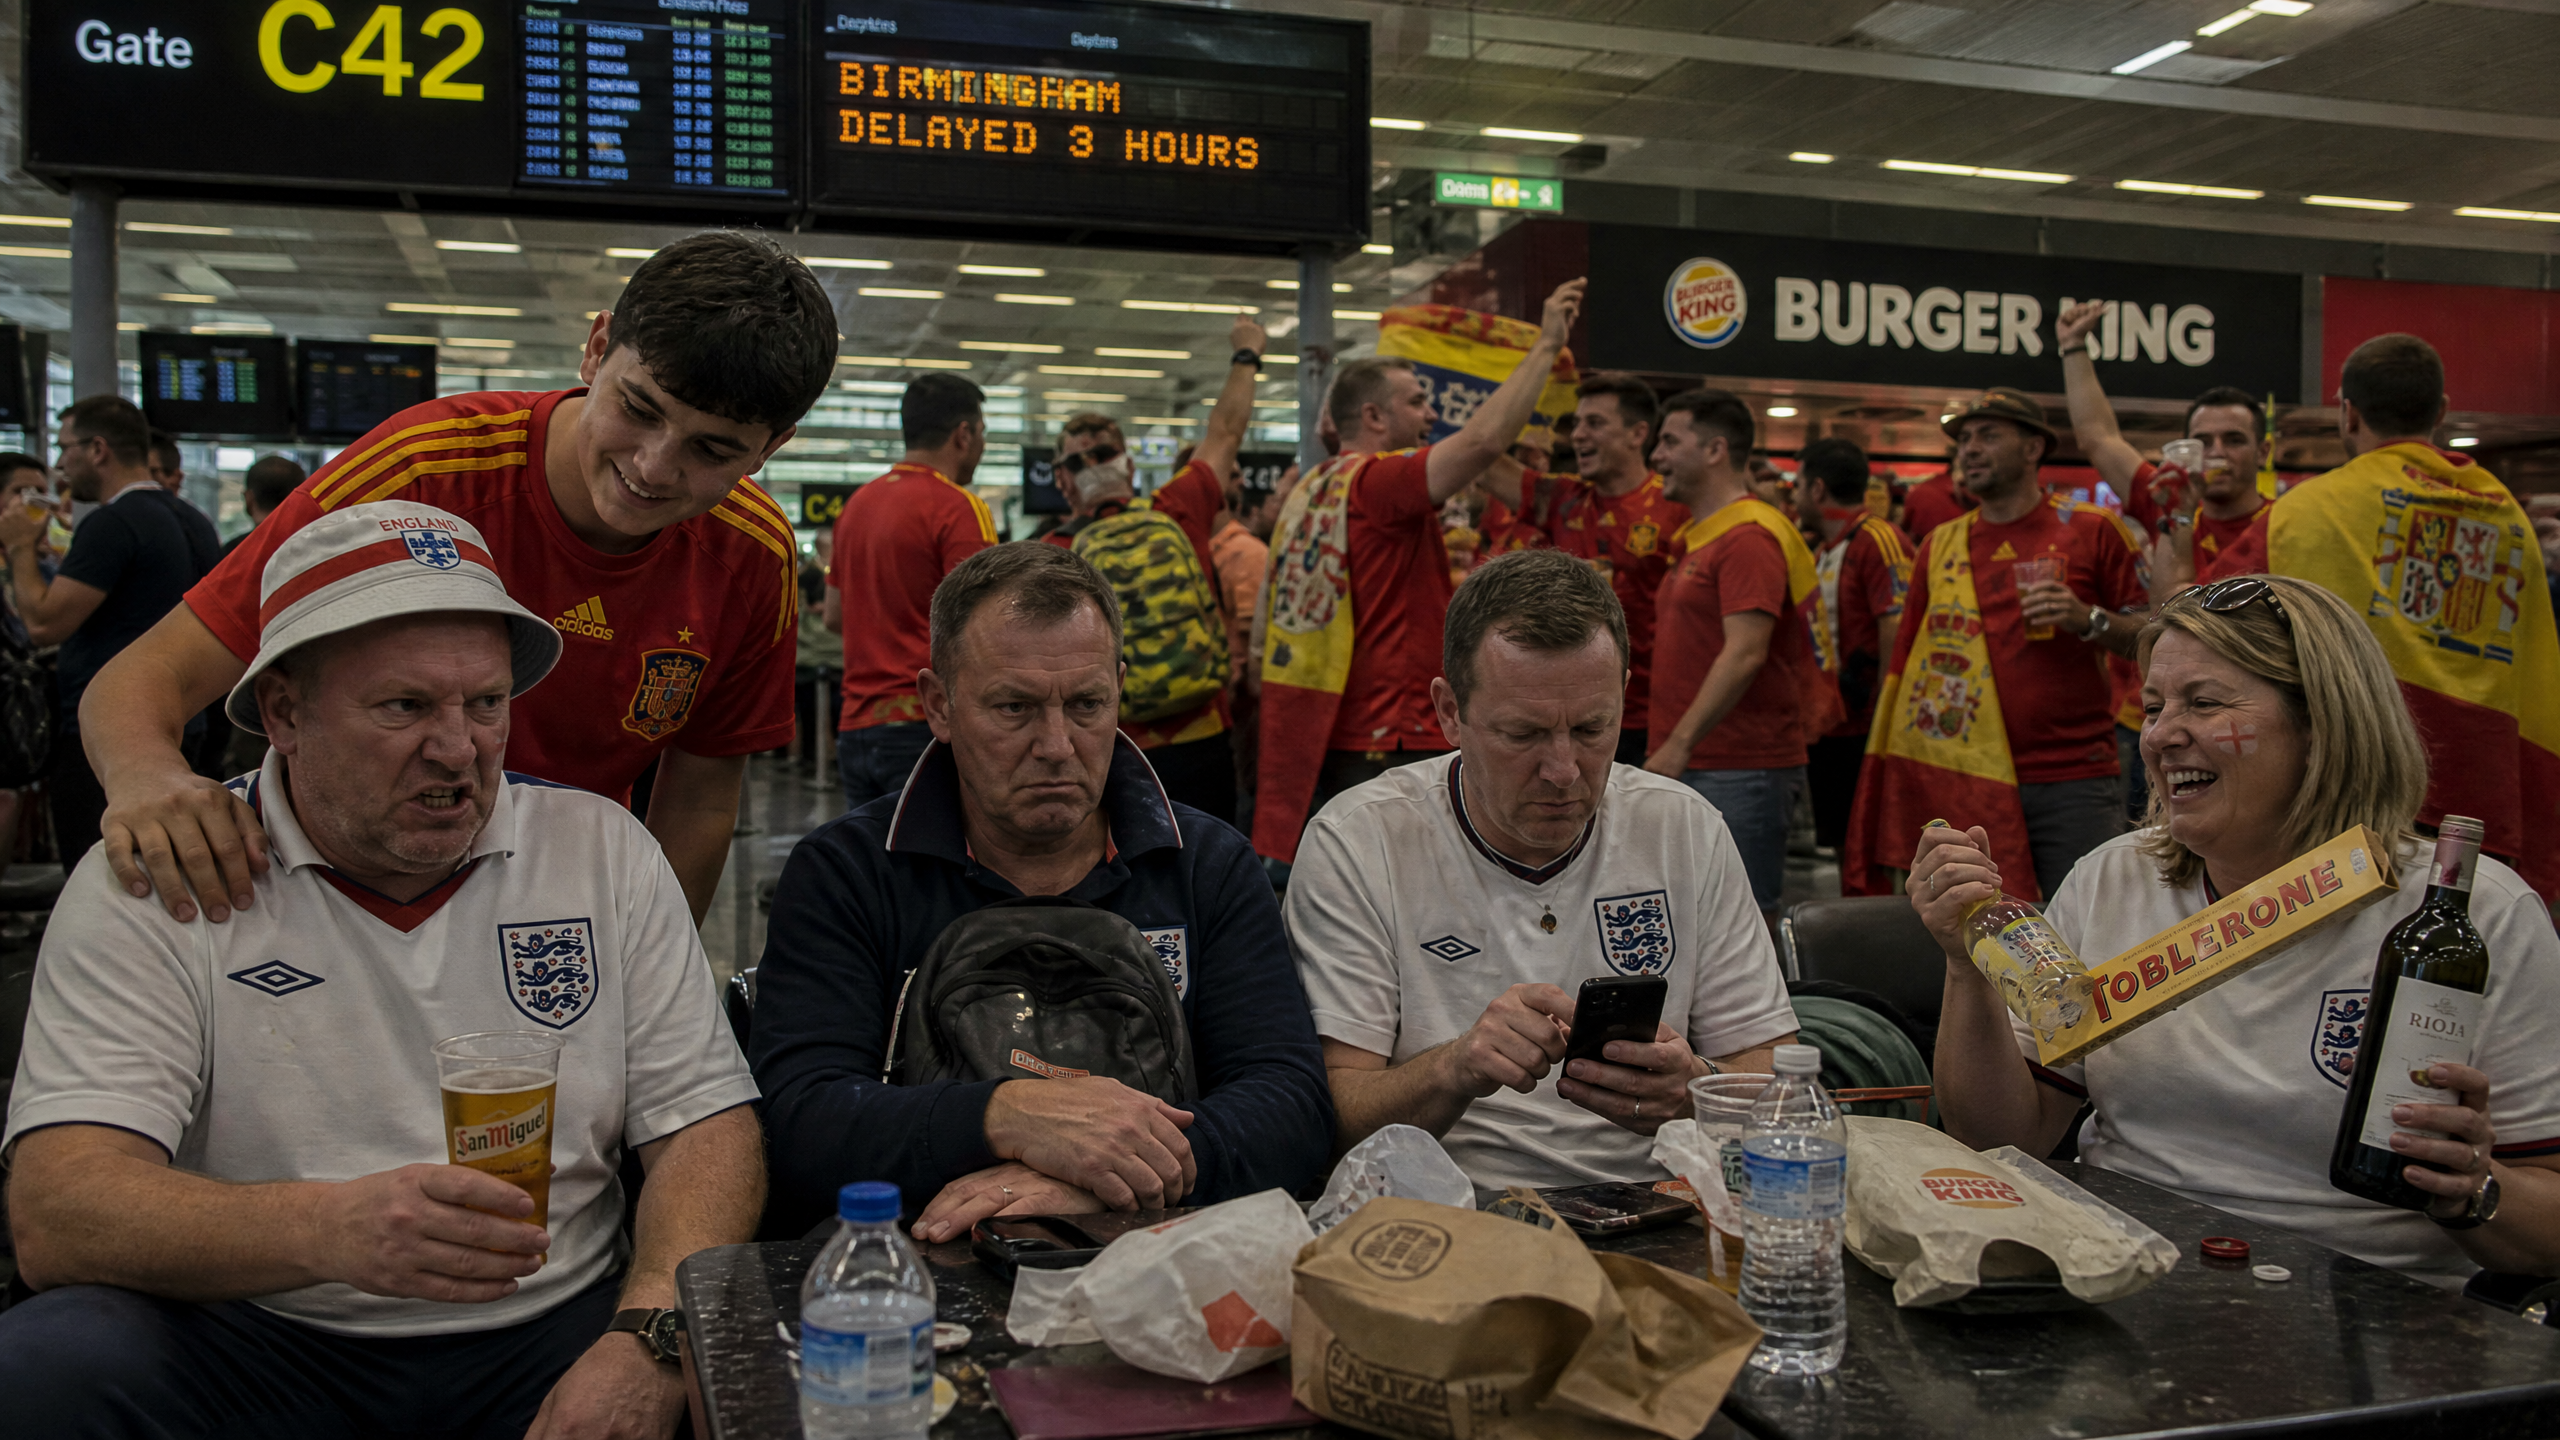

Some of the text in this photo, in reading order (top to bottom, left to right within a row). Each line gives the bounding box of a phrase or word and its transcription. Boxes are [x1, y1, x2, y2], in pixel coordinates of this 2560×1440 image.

[75, 19, 194, 69] Gate
[258, 0, 485, 102] C42
[840, 62, 1120, 113] BIRMINGHAM
[840, 108, 1259, 169] DELAYED 3 HOURS
[1676, 277, 1734, 301] BURGER
[1679, 295, 1736, 323] KING
[1775, 276, 2043, 356] BURGER
[379, 517, 460, 532] ENGLAND
[553, 616, 614, 641] adidas
[2091, 859, 2342, 1023] TOBLERONE
[2409, 1012, 2466, 1038] RIOJA
[1921, 1178, 2016, 1193] BURGER
[1930, 1188, 2025, 1203] KING
